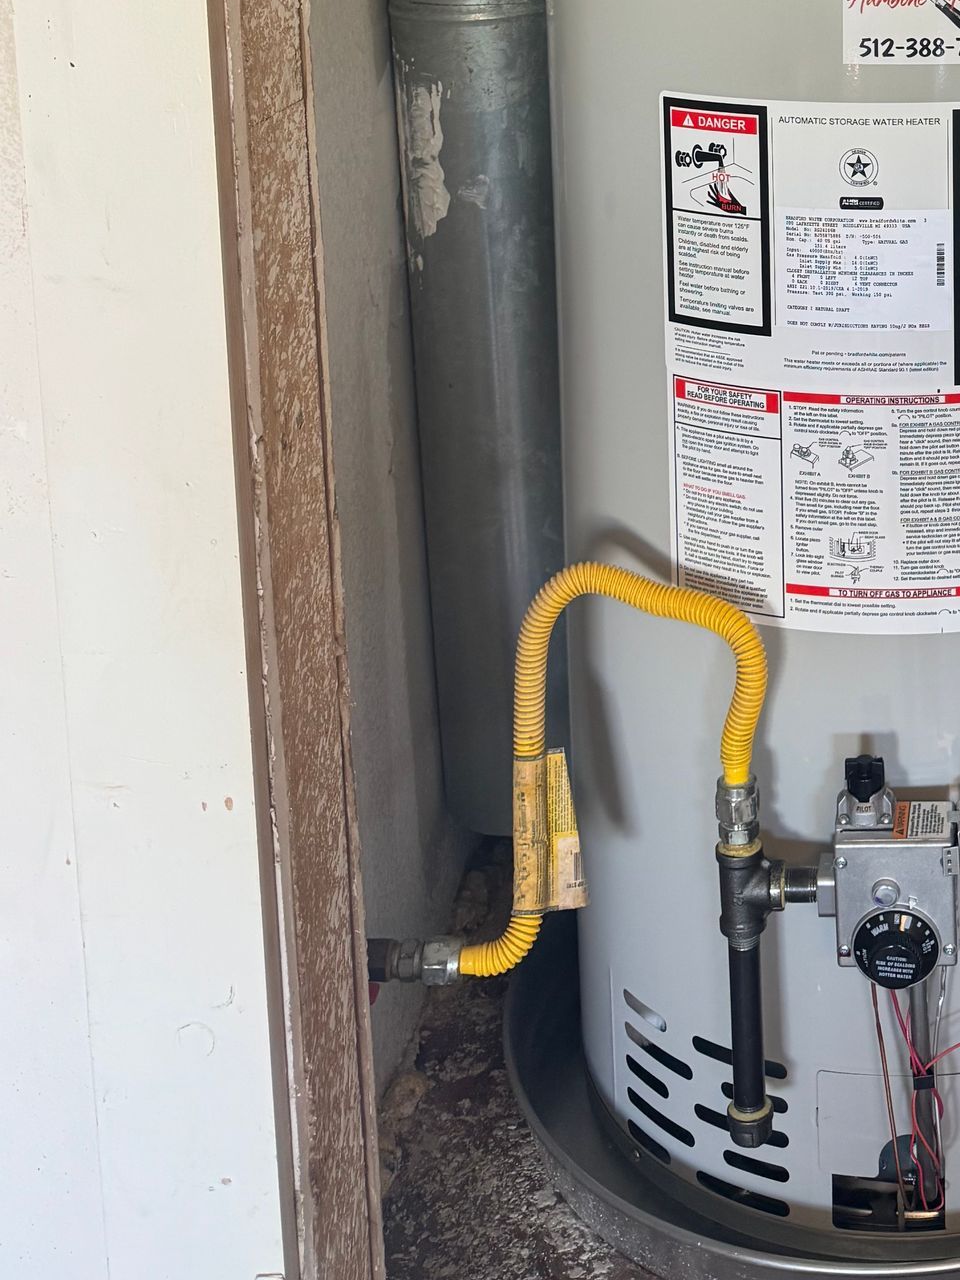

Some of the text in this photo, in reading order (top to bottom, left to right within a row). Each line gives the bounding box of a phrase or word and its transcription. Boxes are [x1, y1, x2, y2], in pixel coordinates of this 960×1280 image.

[698, 117, 746, 130] DANGER
[779, 116, 826, 124] AUTOMATIC
[712, 173, 730, 182] HOT
[692, 217, 720, 226] temperature
[711, 388, 727, 396] YOUR
[729, 390, 752, 399] SAFETY
[687, 391, 764, 408] READ BEFORE OPERATING
[846, 396, 940, 404] OPERATING INSTRUCTIONS
[913, 589, 952, 597] APPLIANCE
[871, 923, 889, 936] WARM
